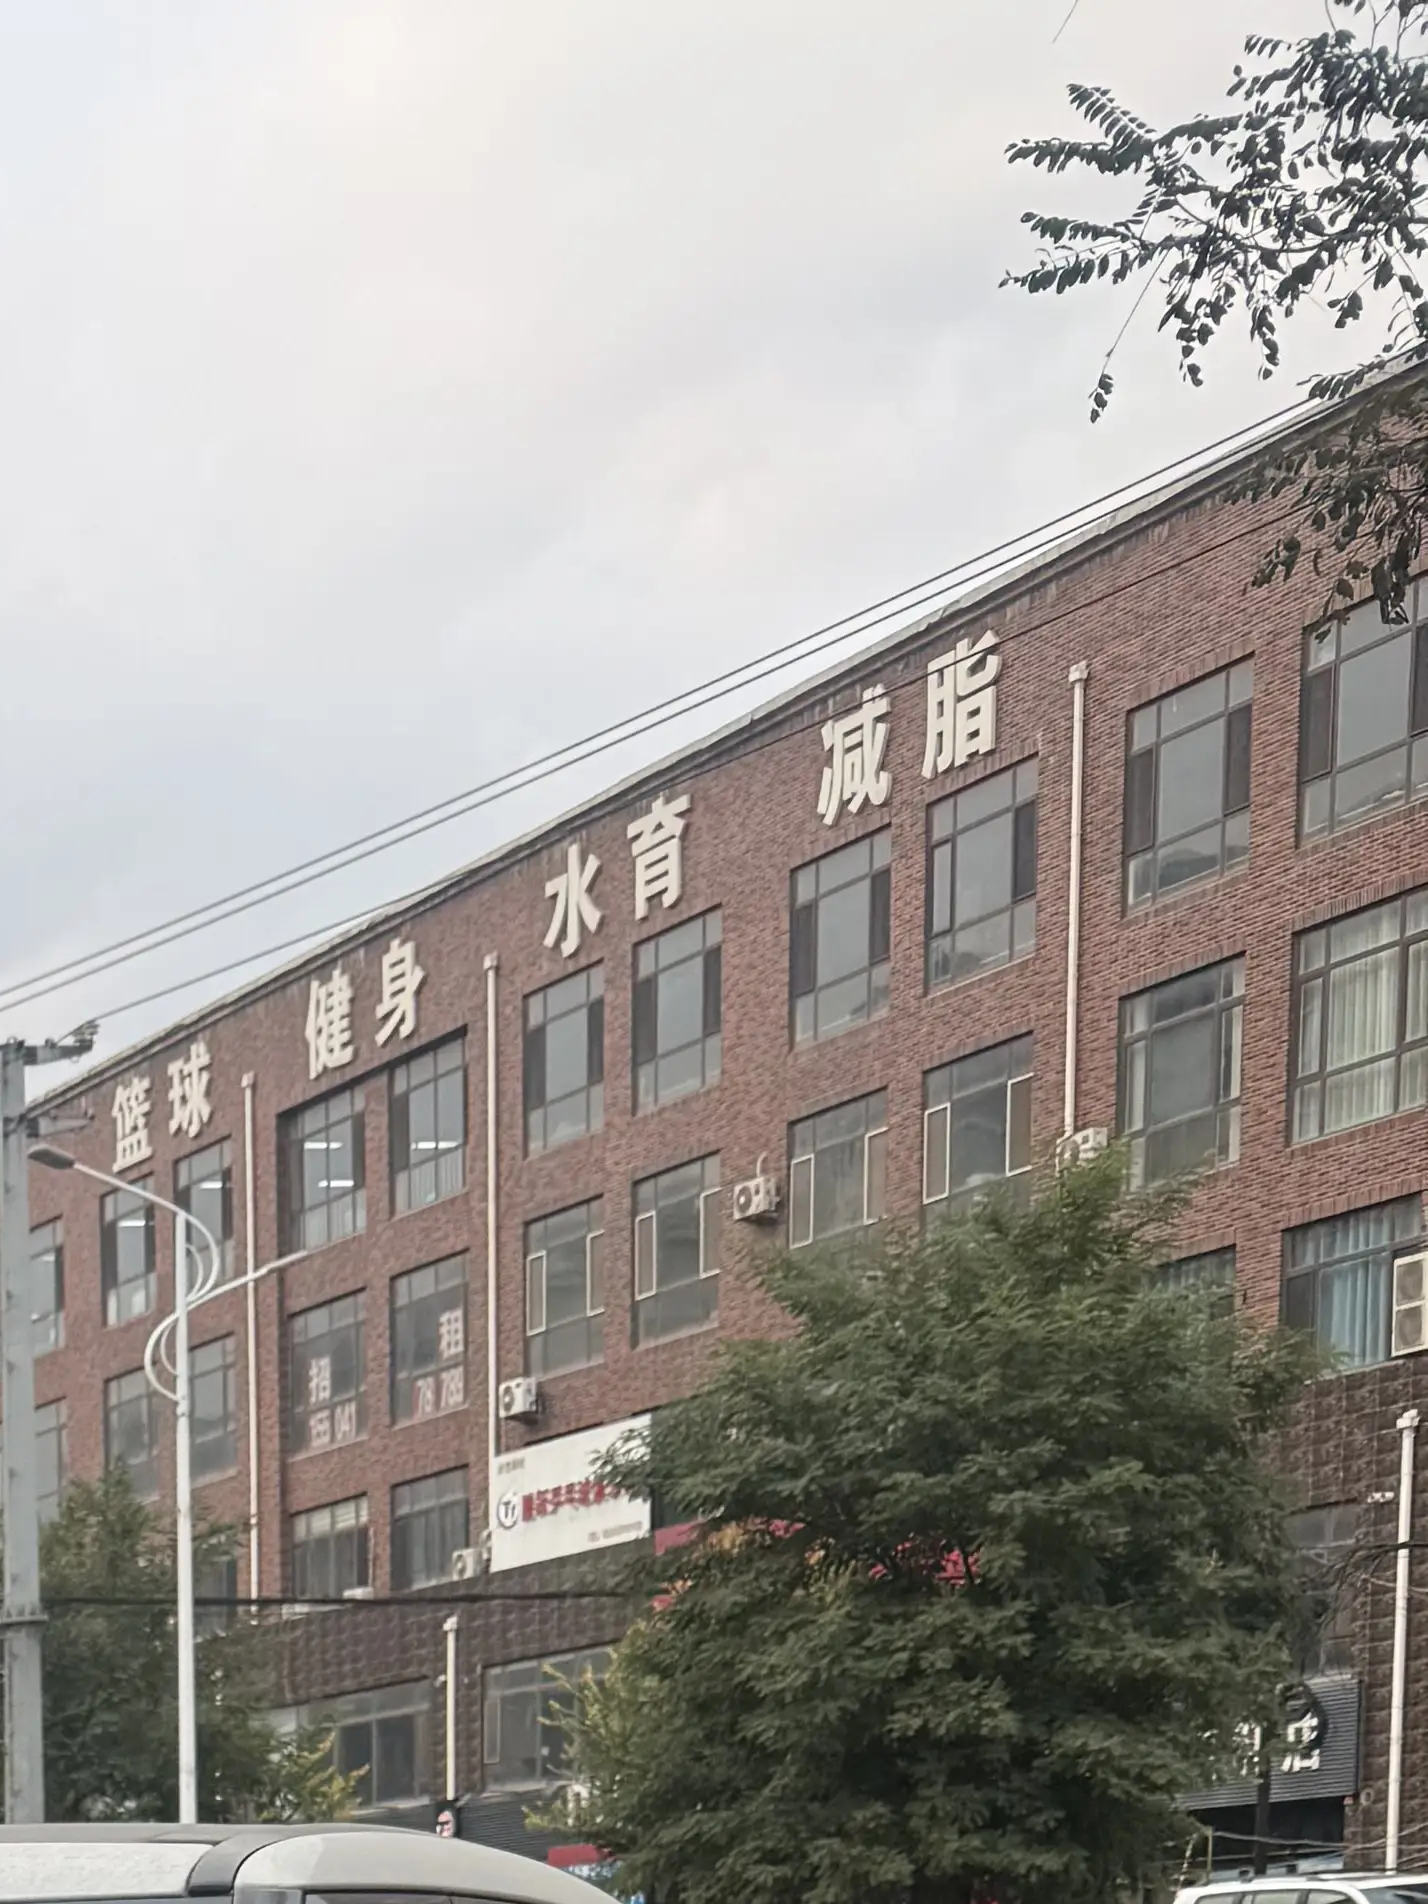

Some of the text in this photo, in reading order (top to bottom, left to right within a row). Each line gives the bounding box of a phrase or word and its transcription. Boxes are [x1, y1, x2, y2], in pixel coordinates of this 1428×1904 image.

[110, 629, 1002, 1172] 篮球 健身 水育 减脂
